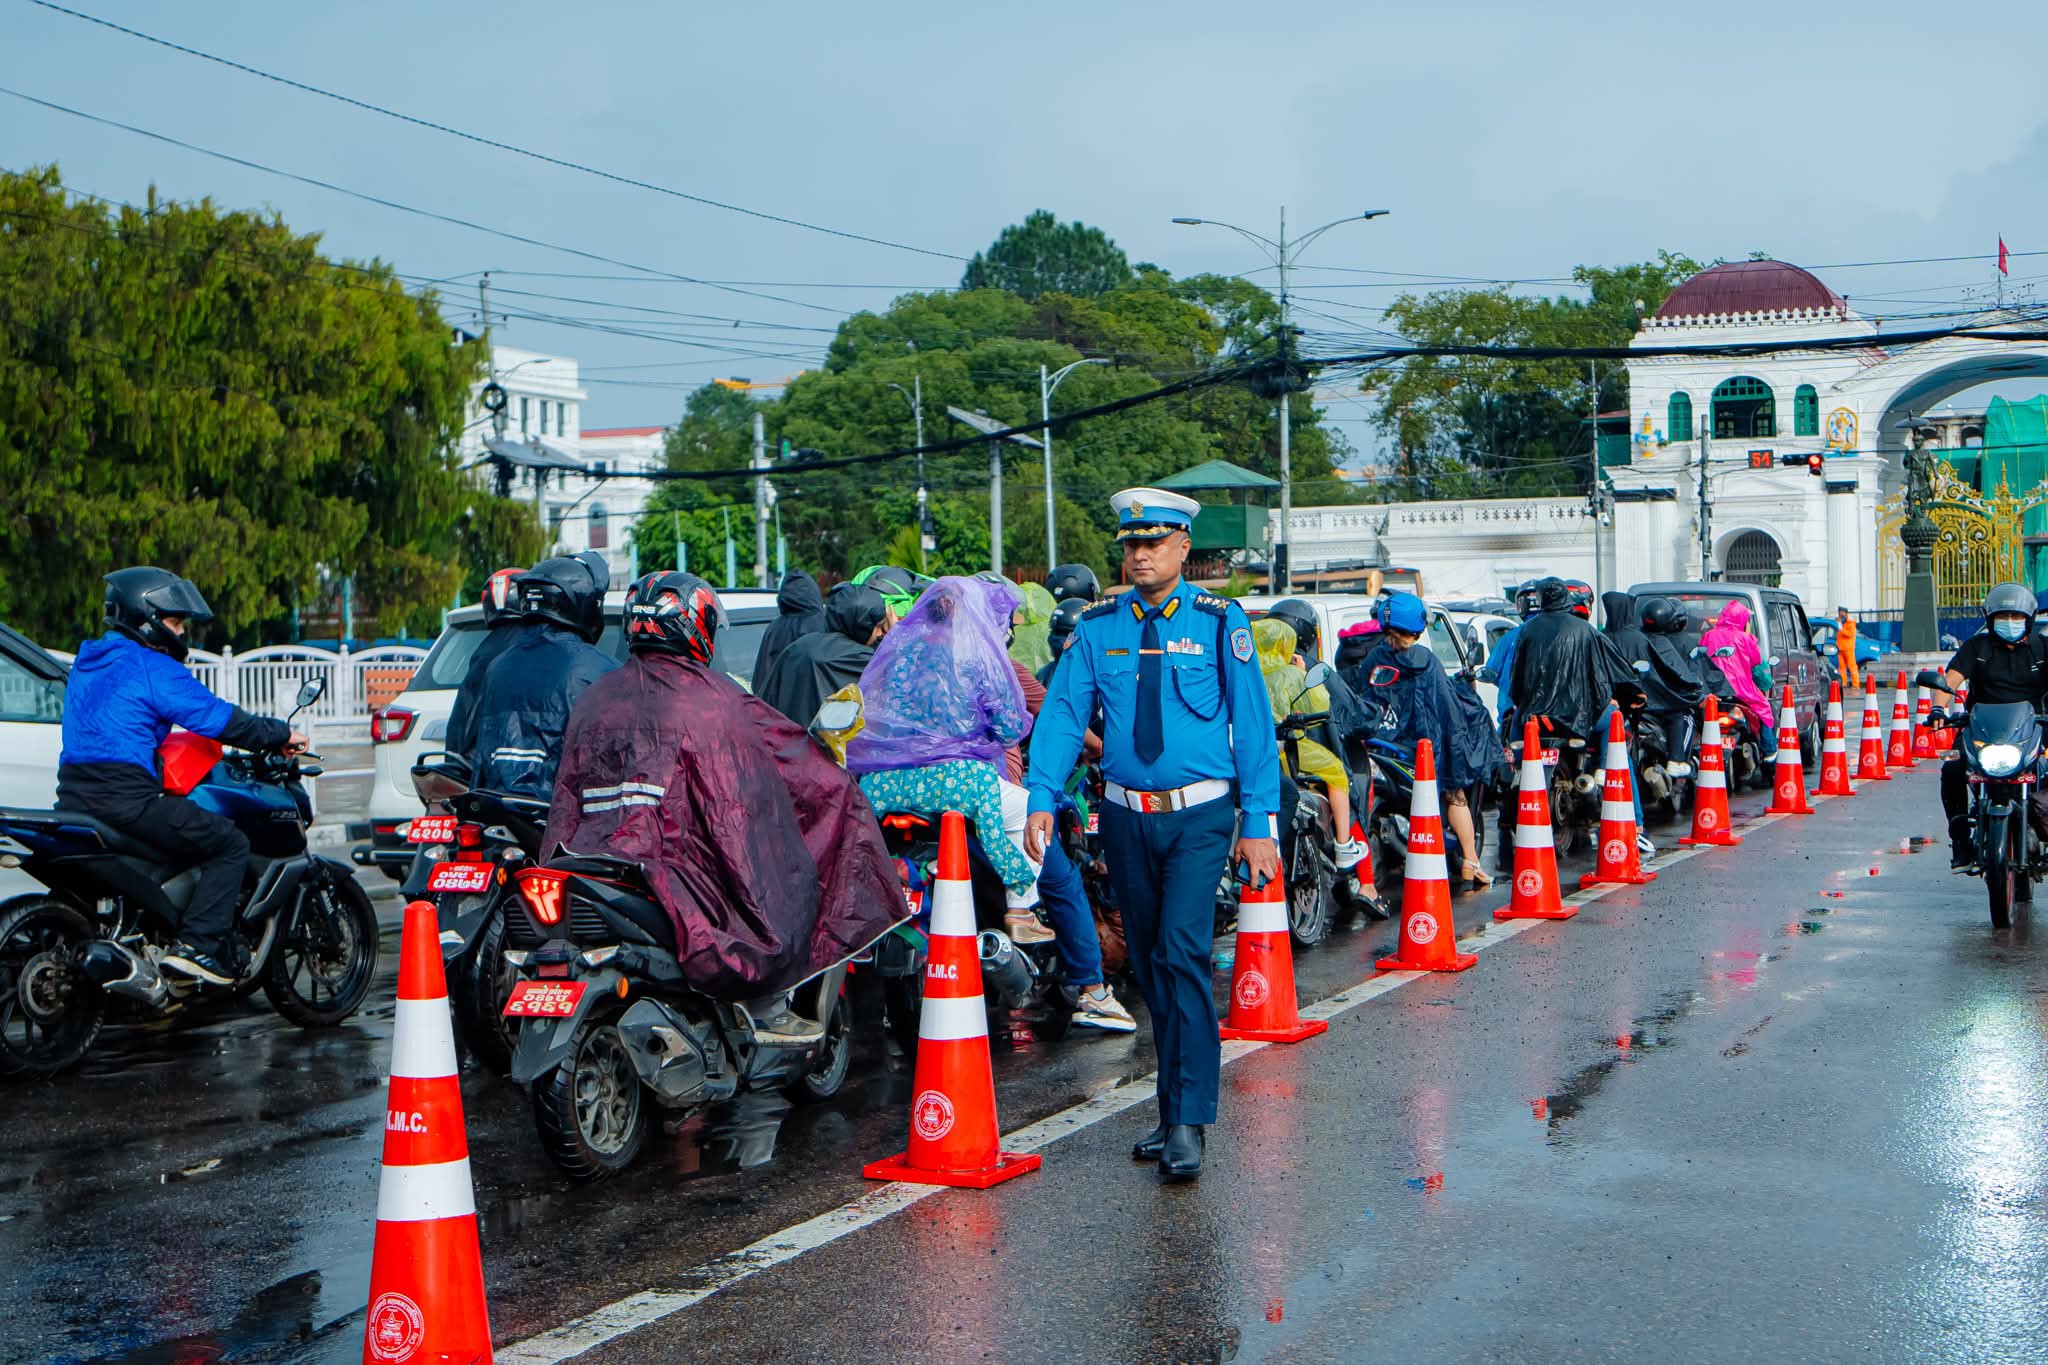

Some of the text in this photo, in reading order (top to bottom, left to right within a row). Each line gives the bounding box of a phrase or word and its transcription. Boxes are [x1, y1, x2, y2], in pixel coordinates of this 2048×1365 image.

[1751, 452, 1770, 468] 54
[1520, 802, 1541, 812] K.M.C.
[1411, 833, 1435, 844] K.M.C.
[927, 963, 959, 980] K.M.C.
